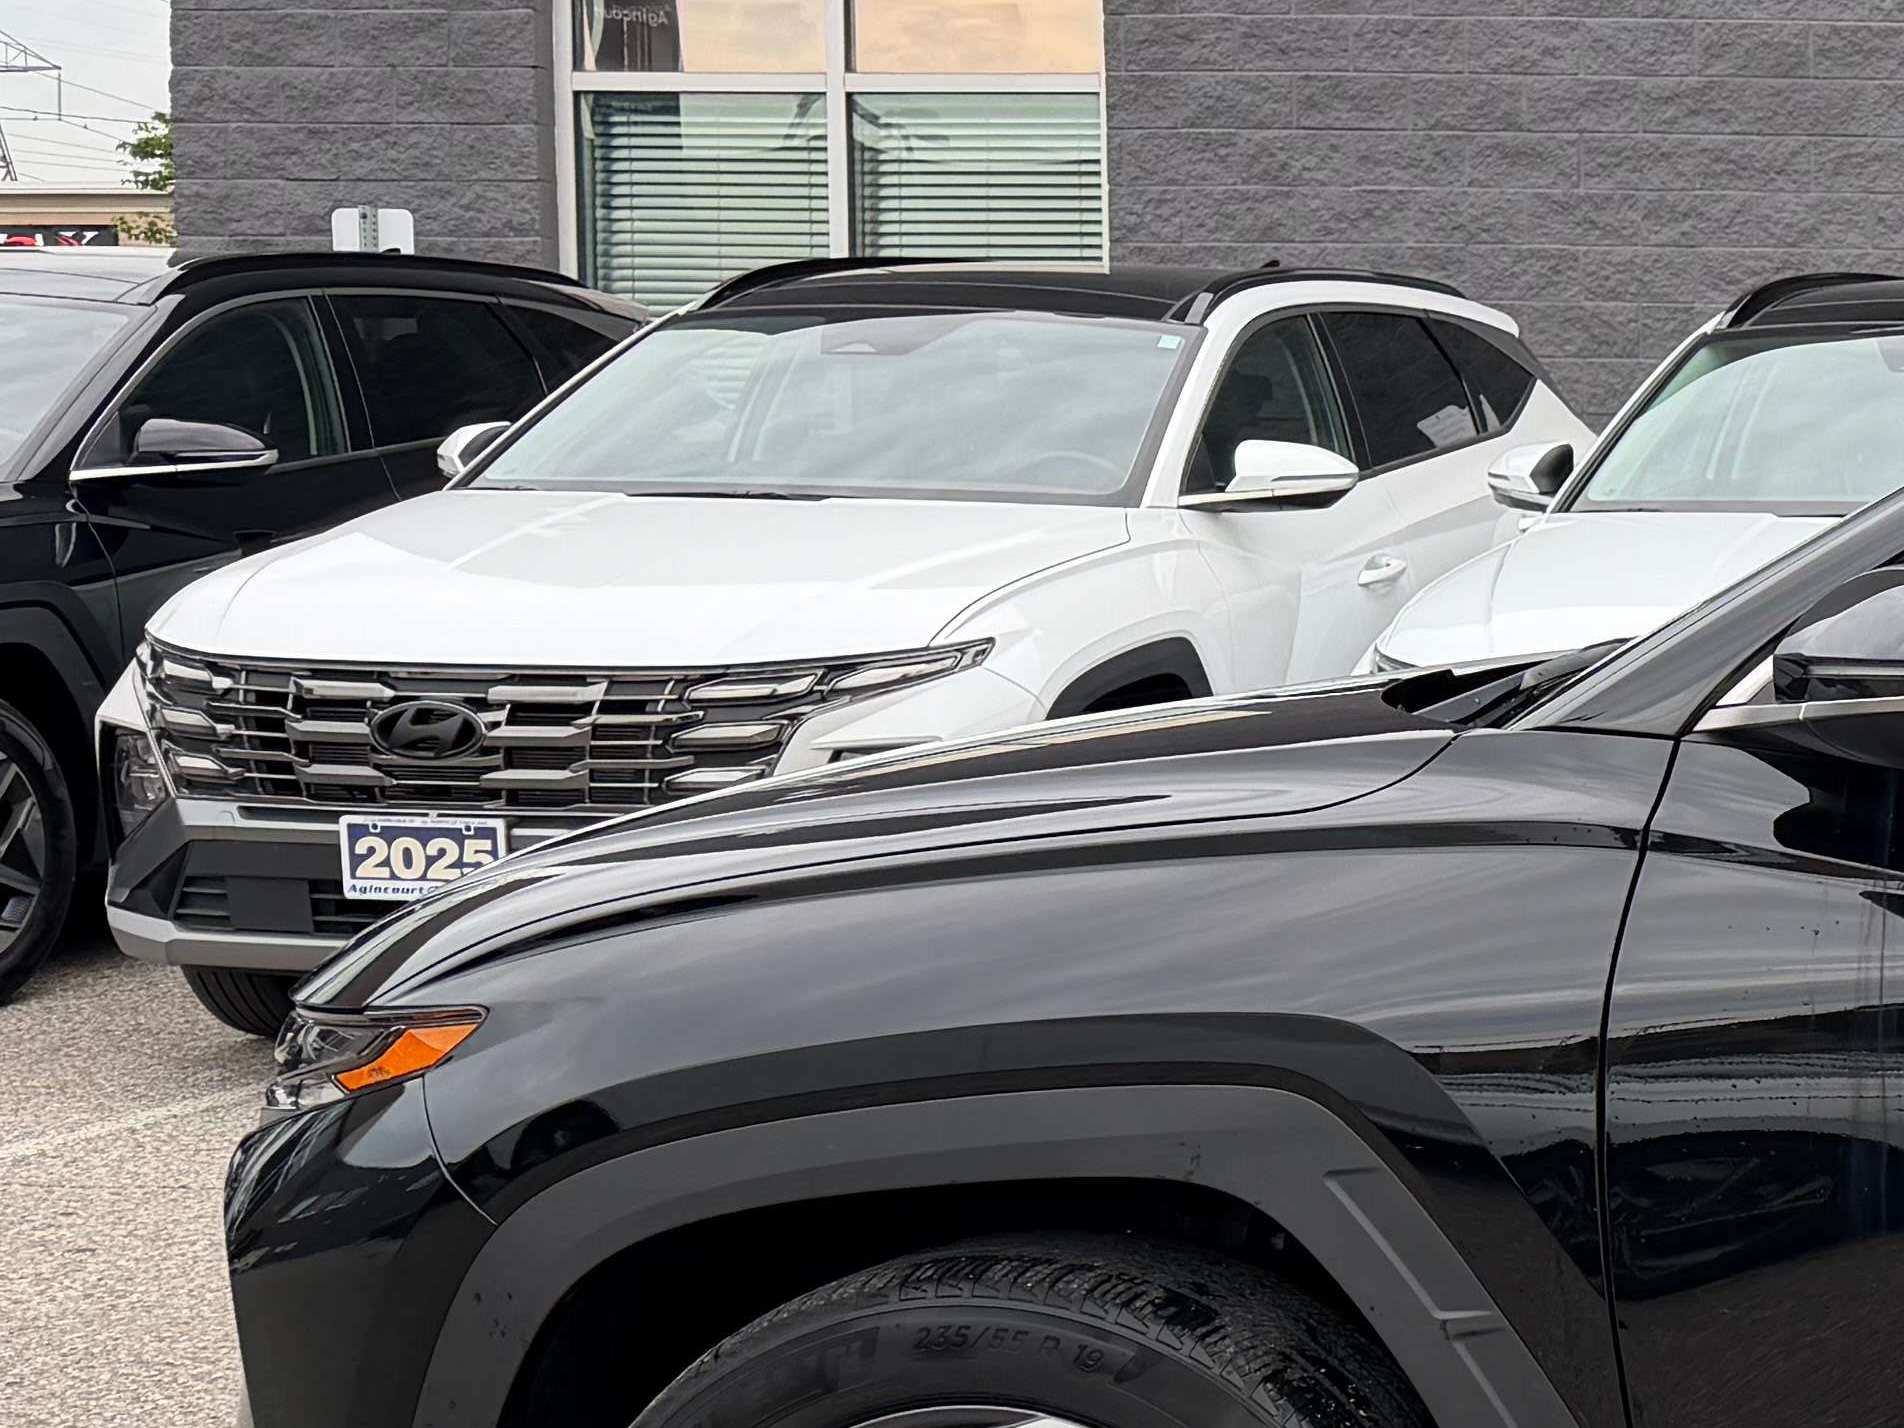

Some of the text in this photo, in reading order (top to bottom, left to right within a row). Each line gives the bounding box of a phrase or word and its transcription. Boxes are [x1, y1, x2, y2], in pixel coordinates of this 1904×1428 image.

[355, 836, 495, 880] 2025
[348, 883, 425, 896] Agincourt
[912, 1323, 1030, 1356] 235/55
[1072, 1342, 1106, 1373] 19
